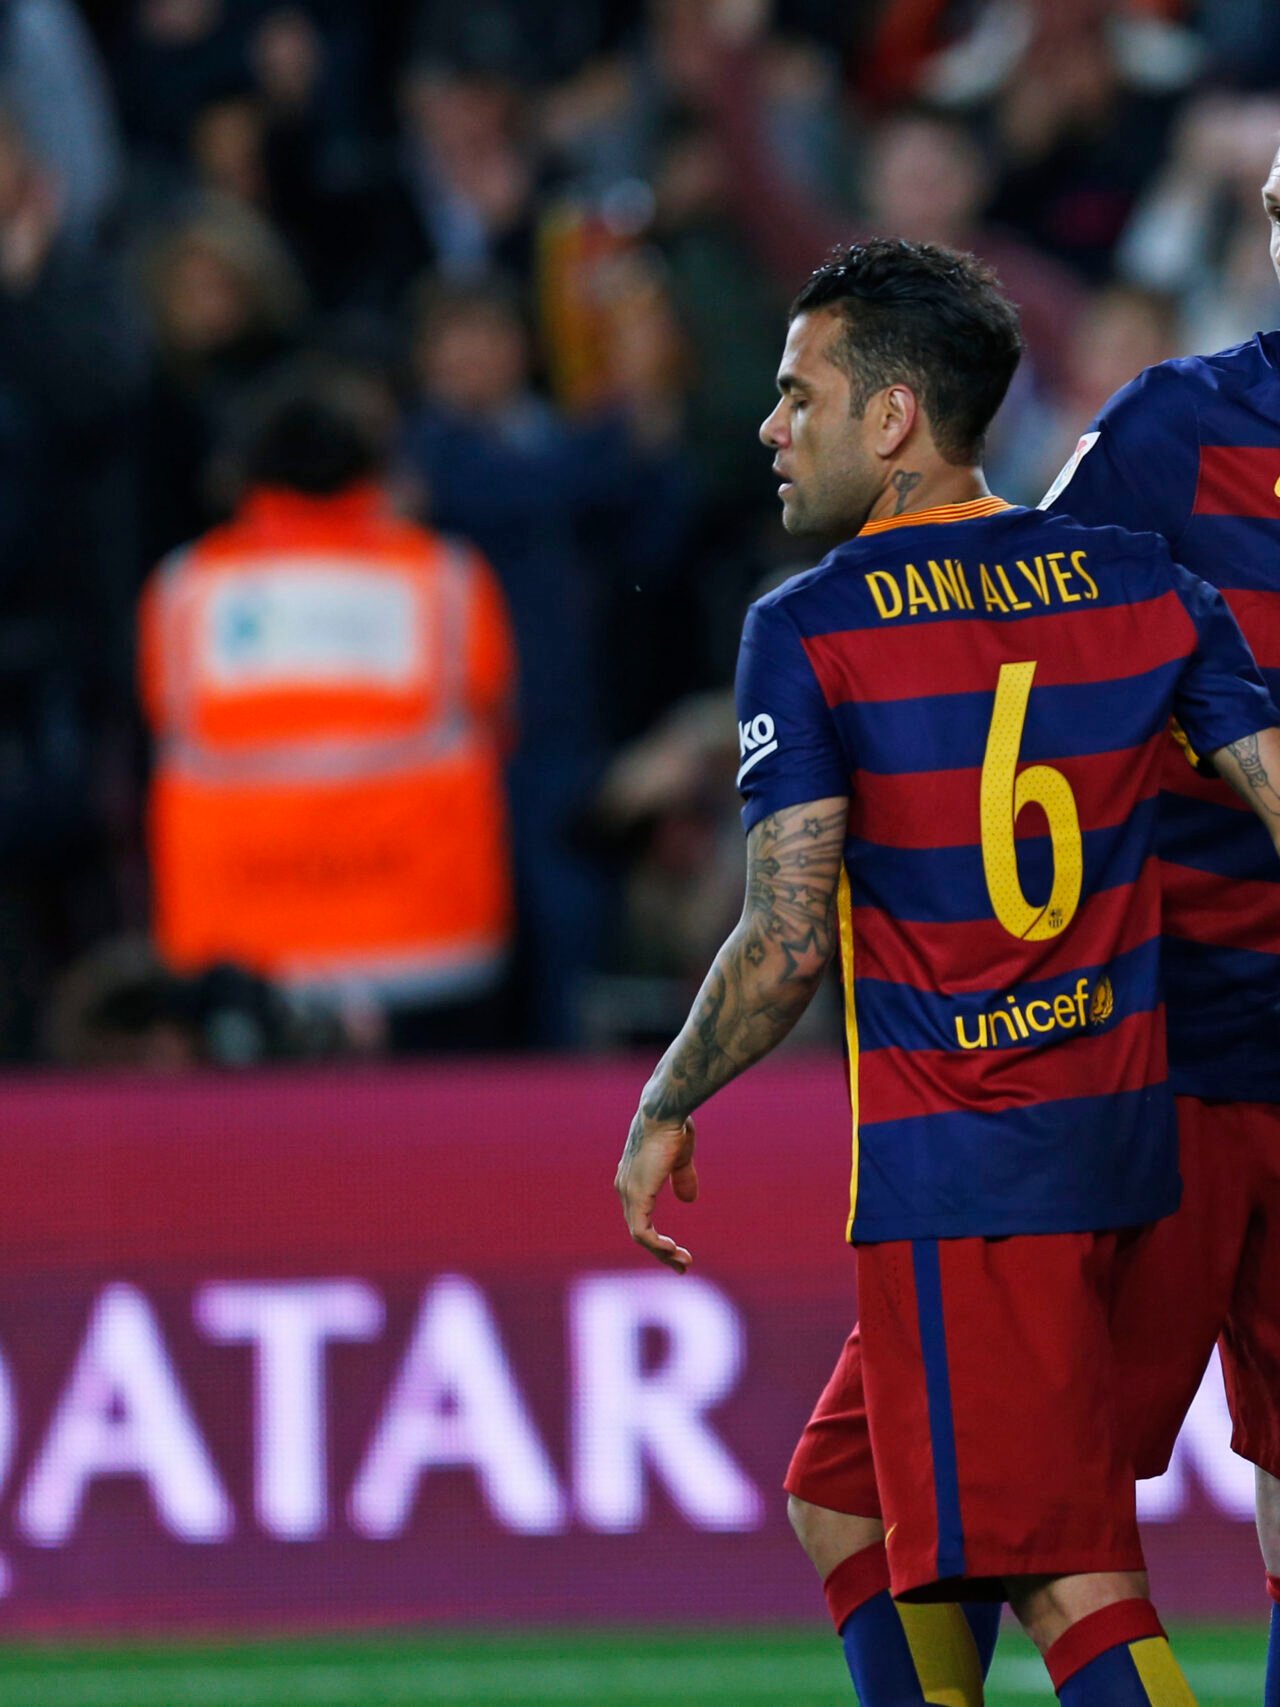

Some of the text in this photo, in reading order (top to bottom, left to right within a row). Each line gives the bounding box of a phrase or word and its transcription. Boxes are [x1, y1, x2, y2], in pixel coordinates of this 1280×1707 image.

[865, 550, 1099, 619] DANI ALVES
[980, 661, 1084, 942] 6
[954, 978, 1091, 1049] unicef
[0, 1272, 766, 1550] ATAR
